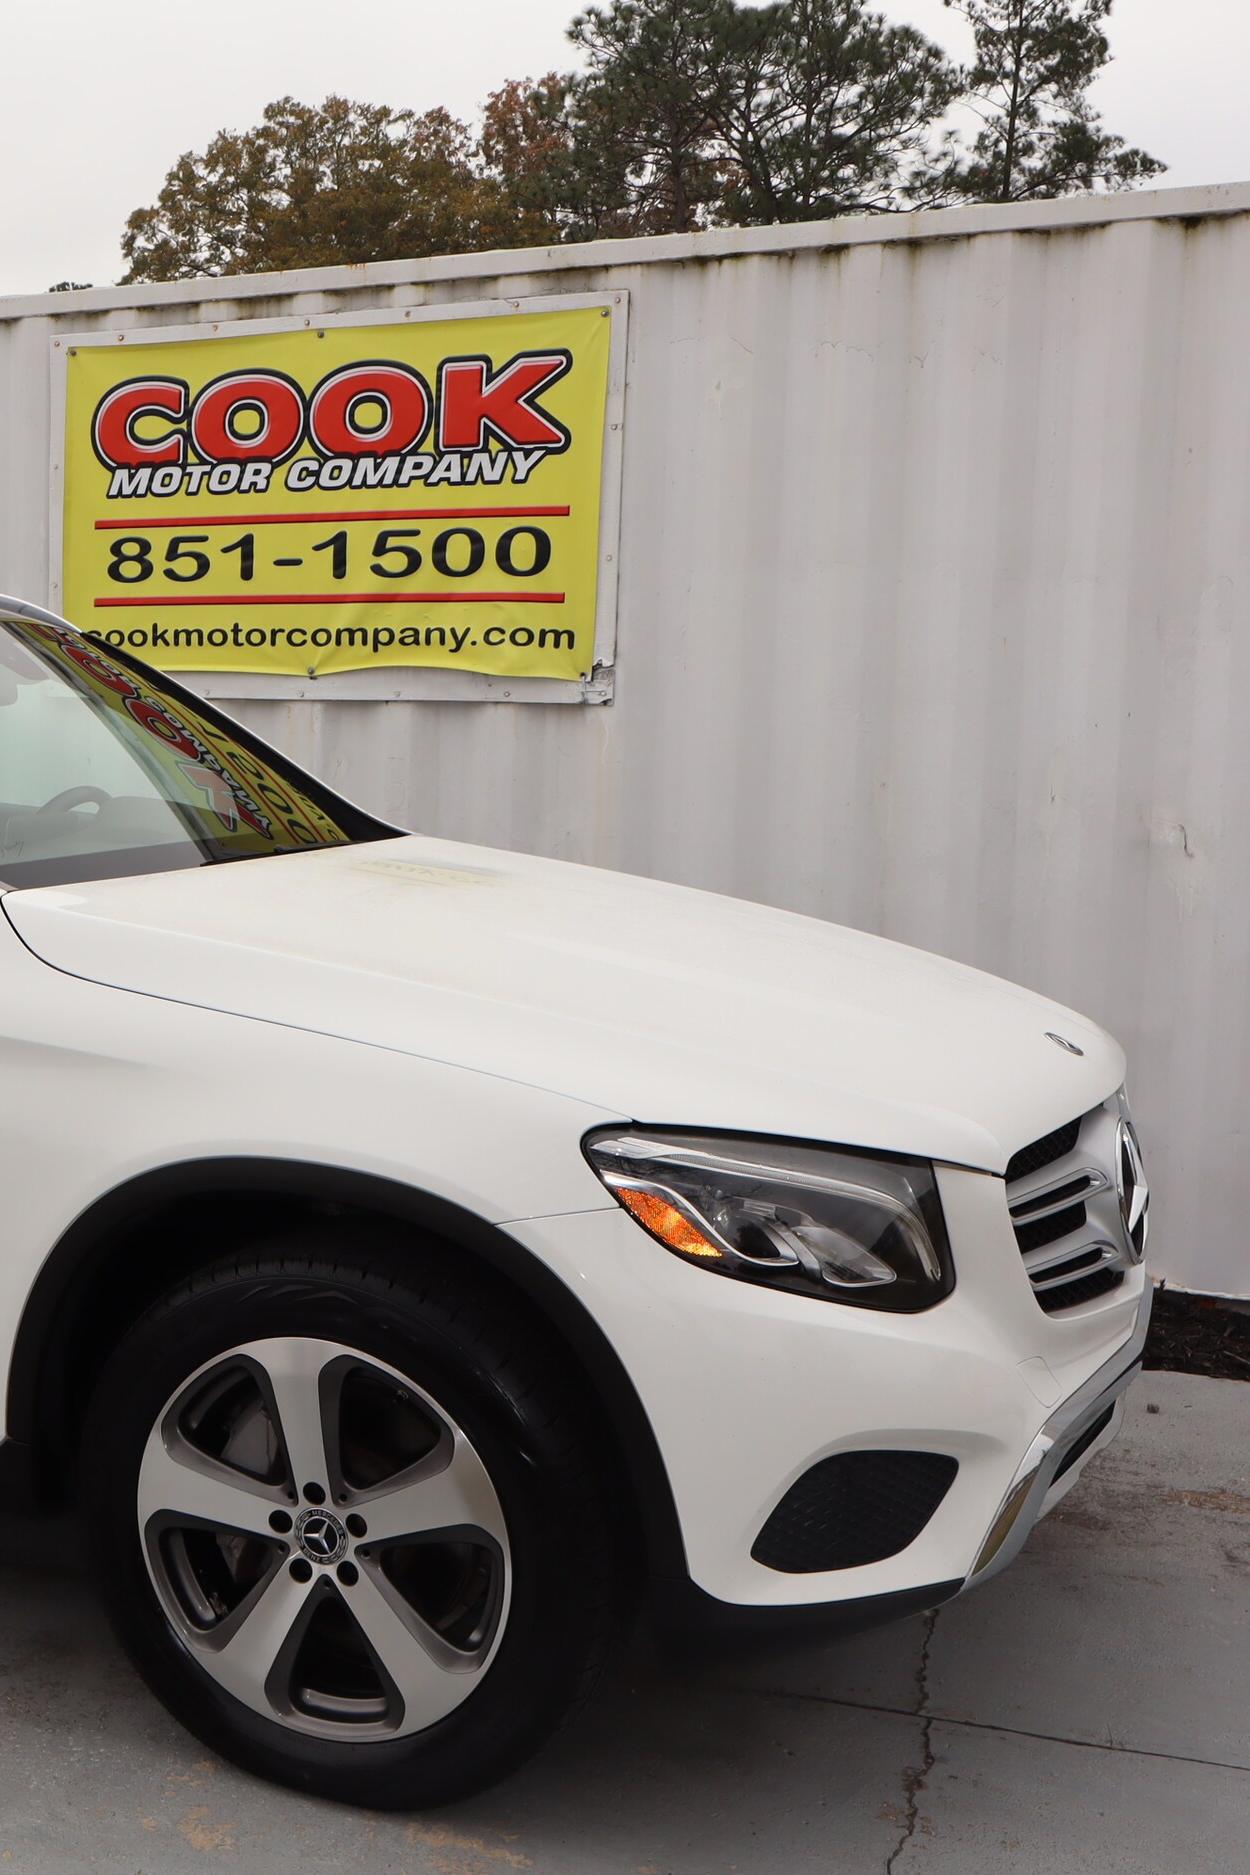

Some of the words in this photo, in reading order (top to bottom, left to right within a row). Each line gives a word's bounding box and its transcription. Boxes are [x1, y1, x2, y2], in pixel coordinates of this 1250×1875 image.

[92, 349, 572, 470] COOK
[107, 462, 272, 498] MOTOR
[284, 449, 547, 491] COMPANY
[107, 525, 552, 583] 851-1500
[311, 1510, 344, 1535] MERCEDES
